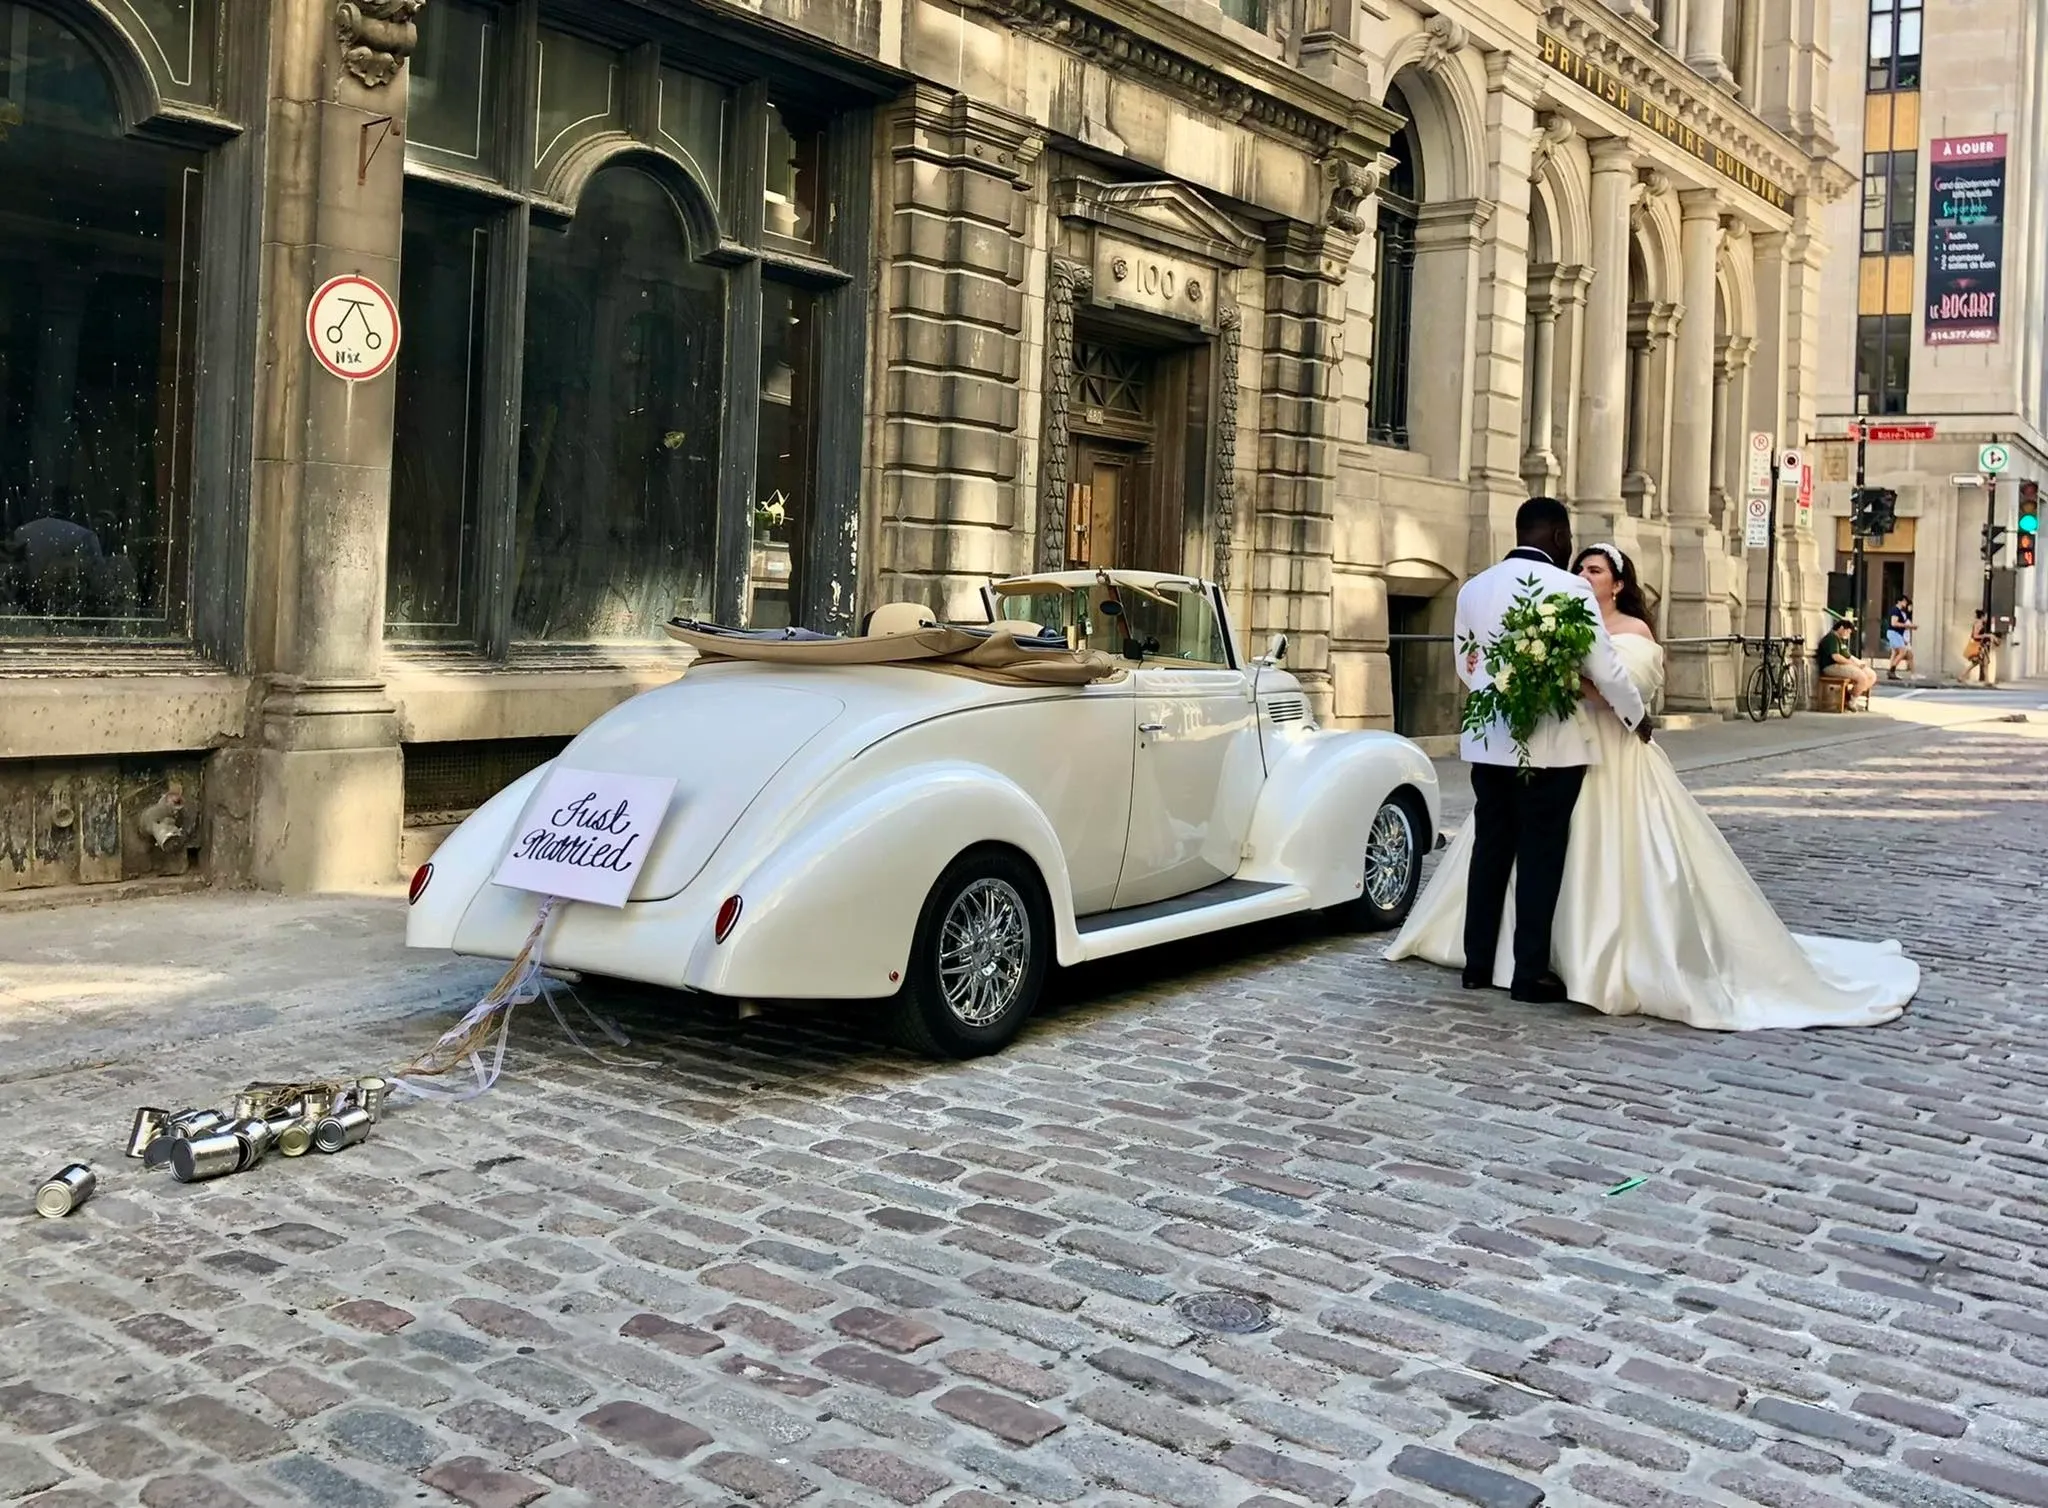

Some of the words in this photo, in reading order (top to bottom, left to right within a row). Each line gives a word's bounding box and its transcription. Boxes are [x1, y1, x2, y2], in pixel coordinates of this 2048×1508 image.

[1543, 36, 1629, 112] BRITISH
[1642, 101, 1705, 158] EMPIRE
[1715, 150, 1785, 207] BUILDING
[1943, 142, 1952, 156] À
[1956, 141, 1994, 155] LOUER
[1136, 259, 1175, 300] 100
[1940, 292, 1996, 319] BOGART
[1877, 430, 1926, 440] Notre-Dame
[551, 792, 631, 835] Just
[513, 828, 640, 872] Married
